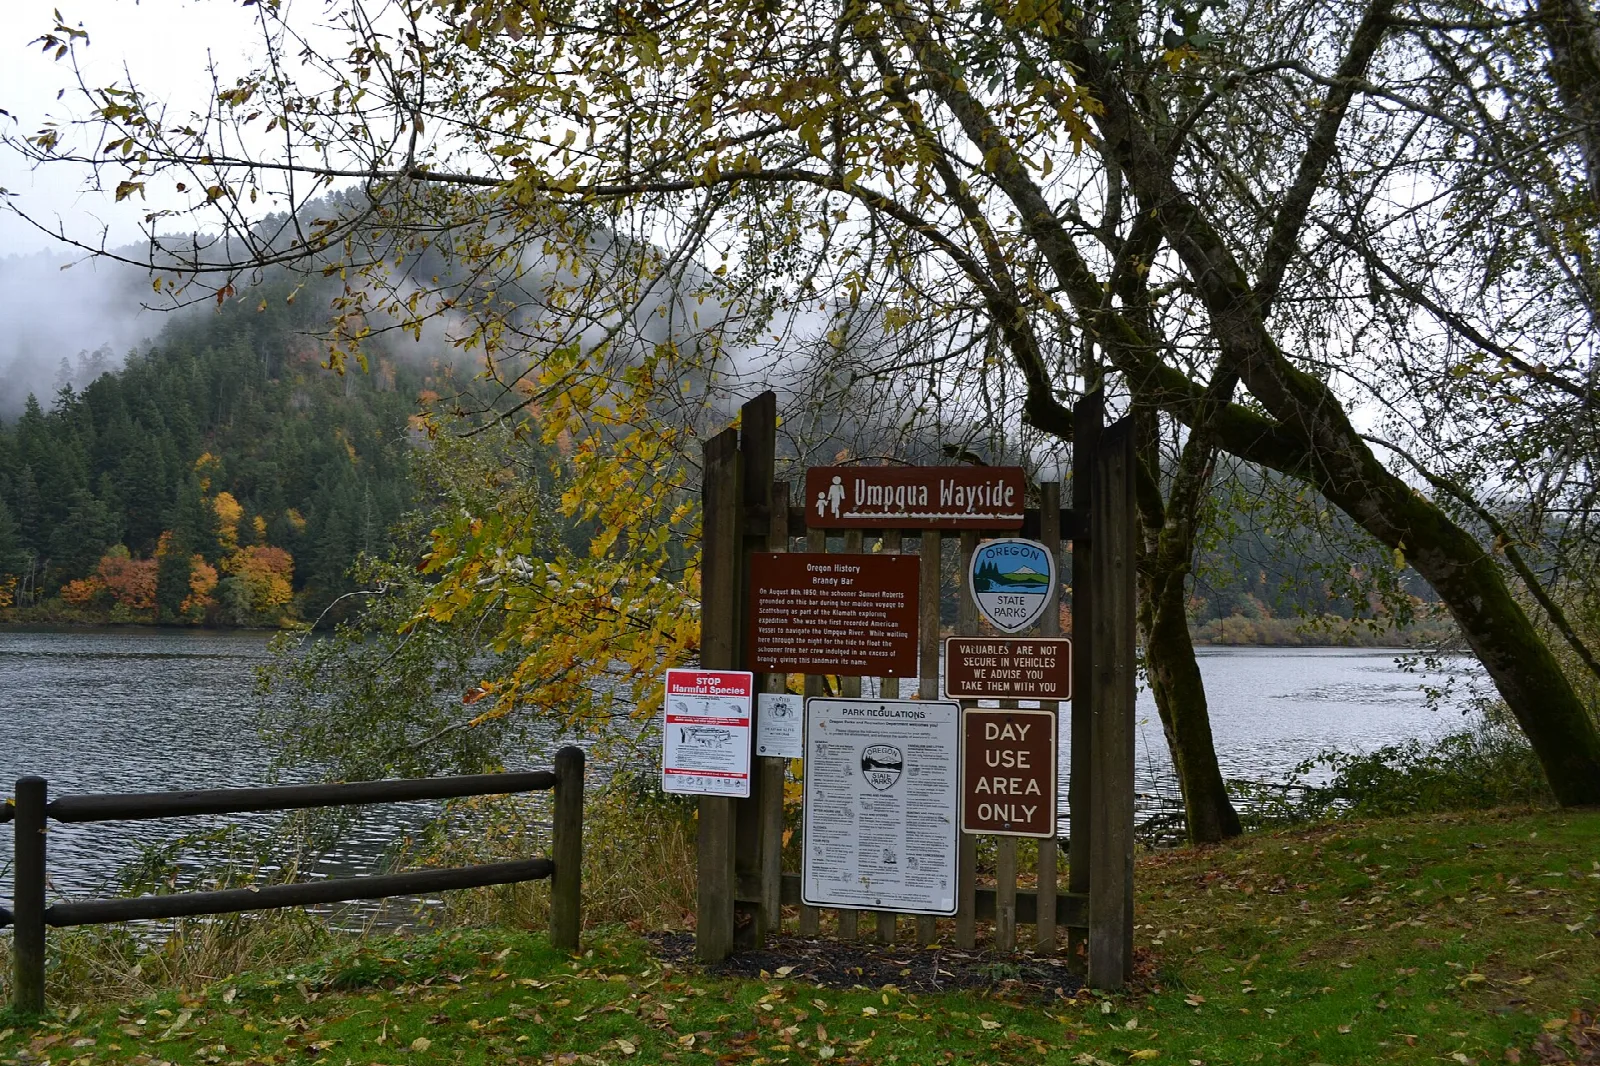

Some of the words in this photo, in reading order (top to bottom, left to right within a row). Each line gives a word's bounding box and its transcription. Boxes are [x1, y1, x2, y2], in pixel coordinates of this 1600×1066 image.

[855, 478, 928, 512] Umpqua
[940, 479, 1015, 513] Wayside
[985, 546, 1040, 561] OREGON
[806, 563, 832, 573] Oregon
[834, 564, 860, 573] History
[812, 577, 838, 586] Brandy
[841, 577, 854, 585] Bar
[997, 595, 1025, 605] STATE
[994, 607, 1027, 618] PARKS
[886, 630, 908, 638] waiting
[807, 638, 822, 646] night
[825, 648, 850, 656] indulged
[960, 645, 1009, 655] VALUABLES
[1016, 646, 1033, 655] ARE
[1040, 646, 1057, 655] NOT
[963, 657, 997, 667] SECURE
[1000, 657, 1010, 667] IN
[1013, 657, 1056, 668] VEHICLES
[973, 669, 987, 679] WE
[990, 669, 1022, 679] ADVISE
[1025, 670, 1044, 680] YOU
[696, 677, 721, 686] STOP
[961, 680, 983, 691] TAKE
[987, 681, 1010, 691] THEM
[1013, 682, 1035, 692] WITH
[1038, 682, 1057, 692] YOU
[672, 684, 707, 694] Harmful
[709, 685, 745, 695] Species
[866, 709, 926, 718] REGULATIONS
[985, 722, 1031, 741] DAY
[867, 748, 898, 757] OREGON
[985, 749, 1031, 769] USE
[974, 776, 1042, 796] AREA
[977, 803, 1037, 823] ONLY
